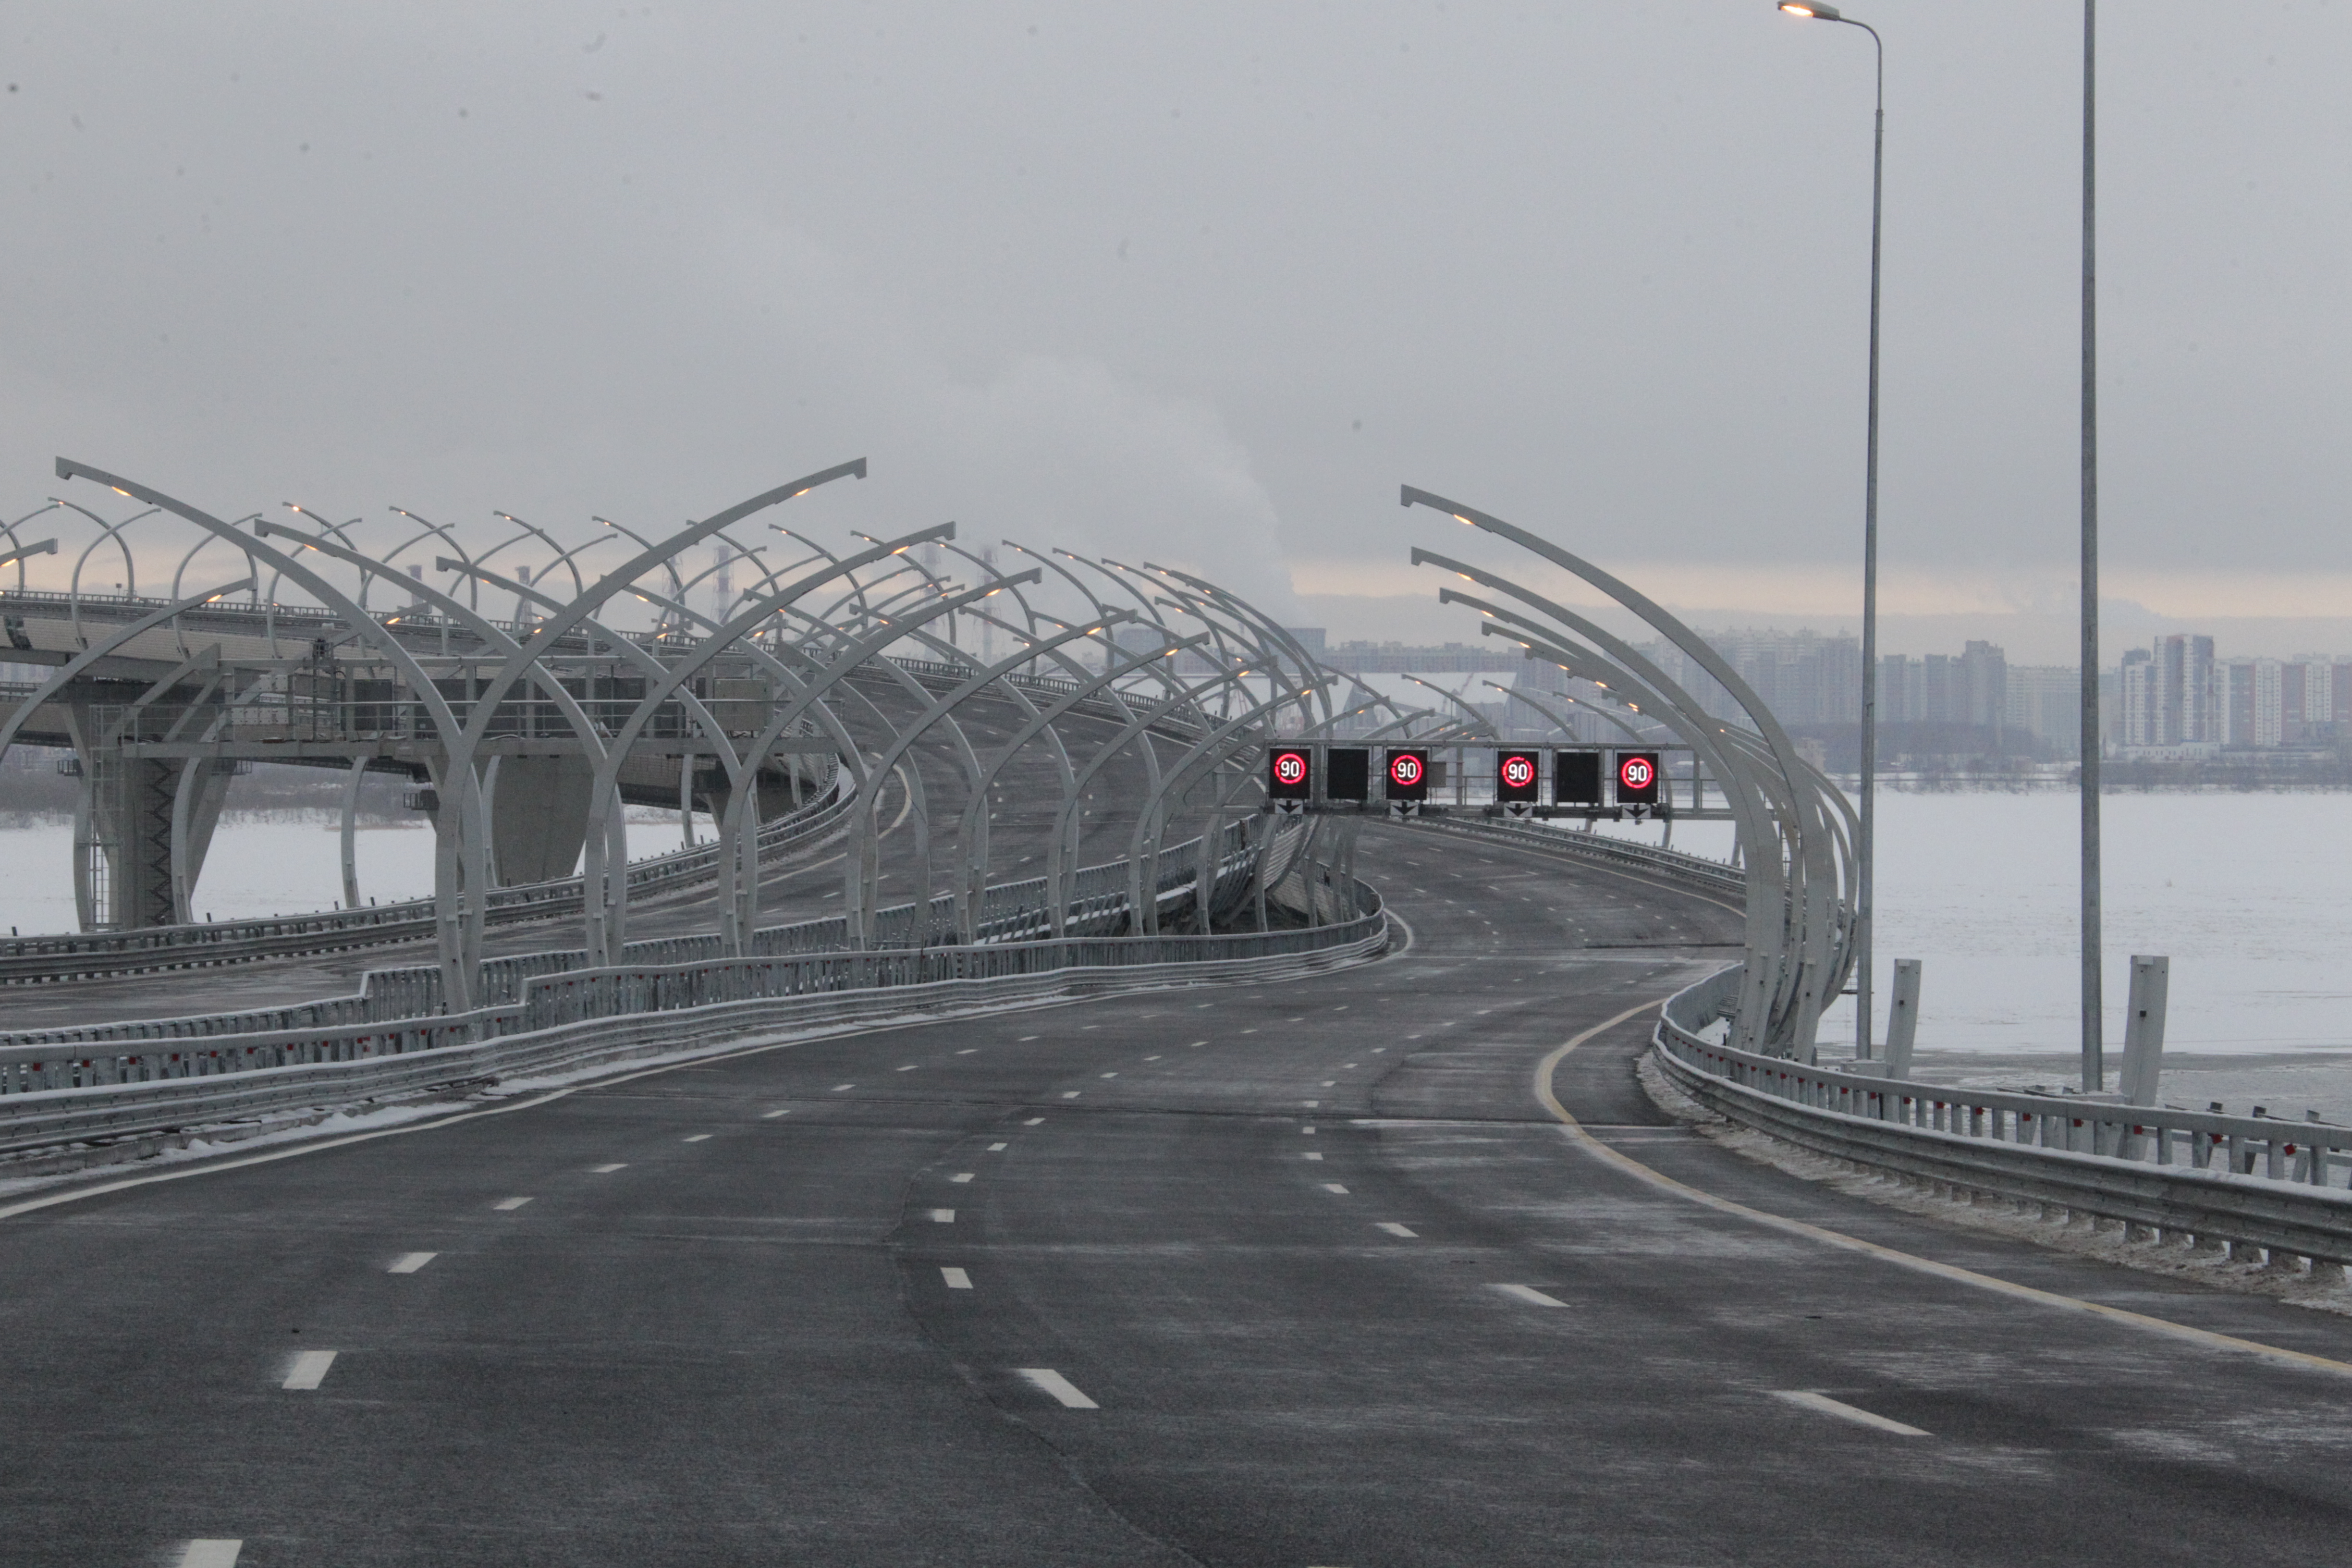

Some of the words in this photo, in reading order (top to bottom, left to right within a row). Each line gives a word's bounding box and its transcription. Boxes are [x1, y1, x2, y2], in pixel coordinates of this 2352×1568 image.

[1281, 761, 1300, 777] 90
[1397, 762, 1416, 778] 90
[1508, 764, 1528, 780] 90
[1628, 765, 1647, 782] 90
